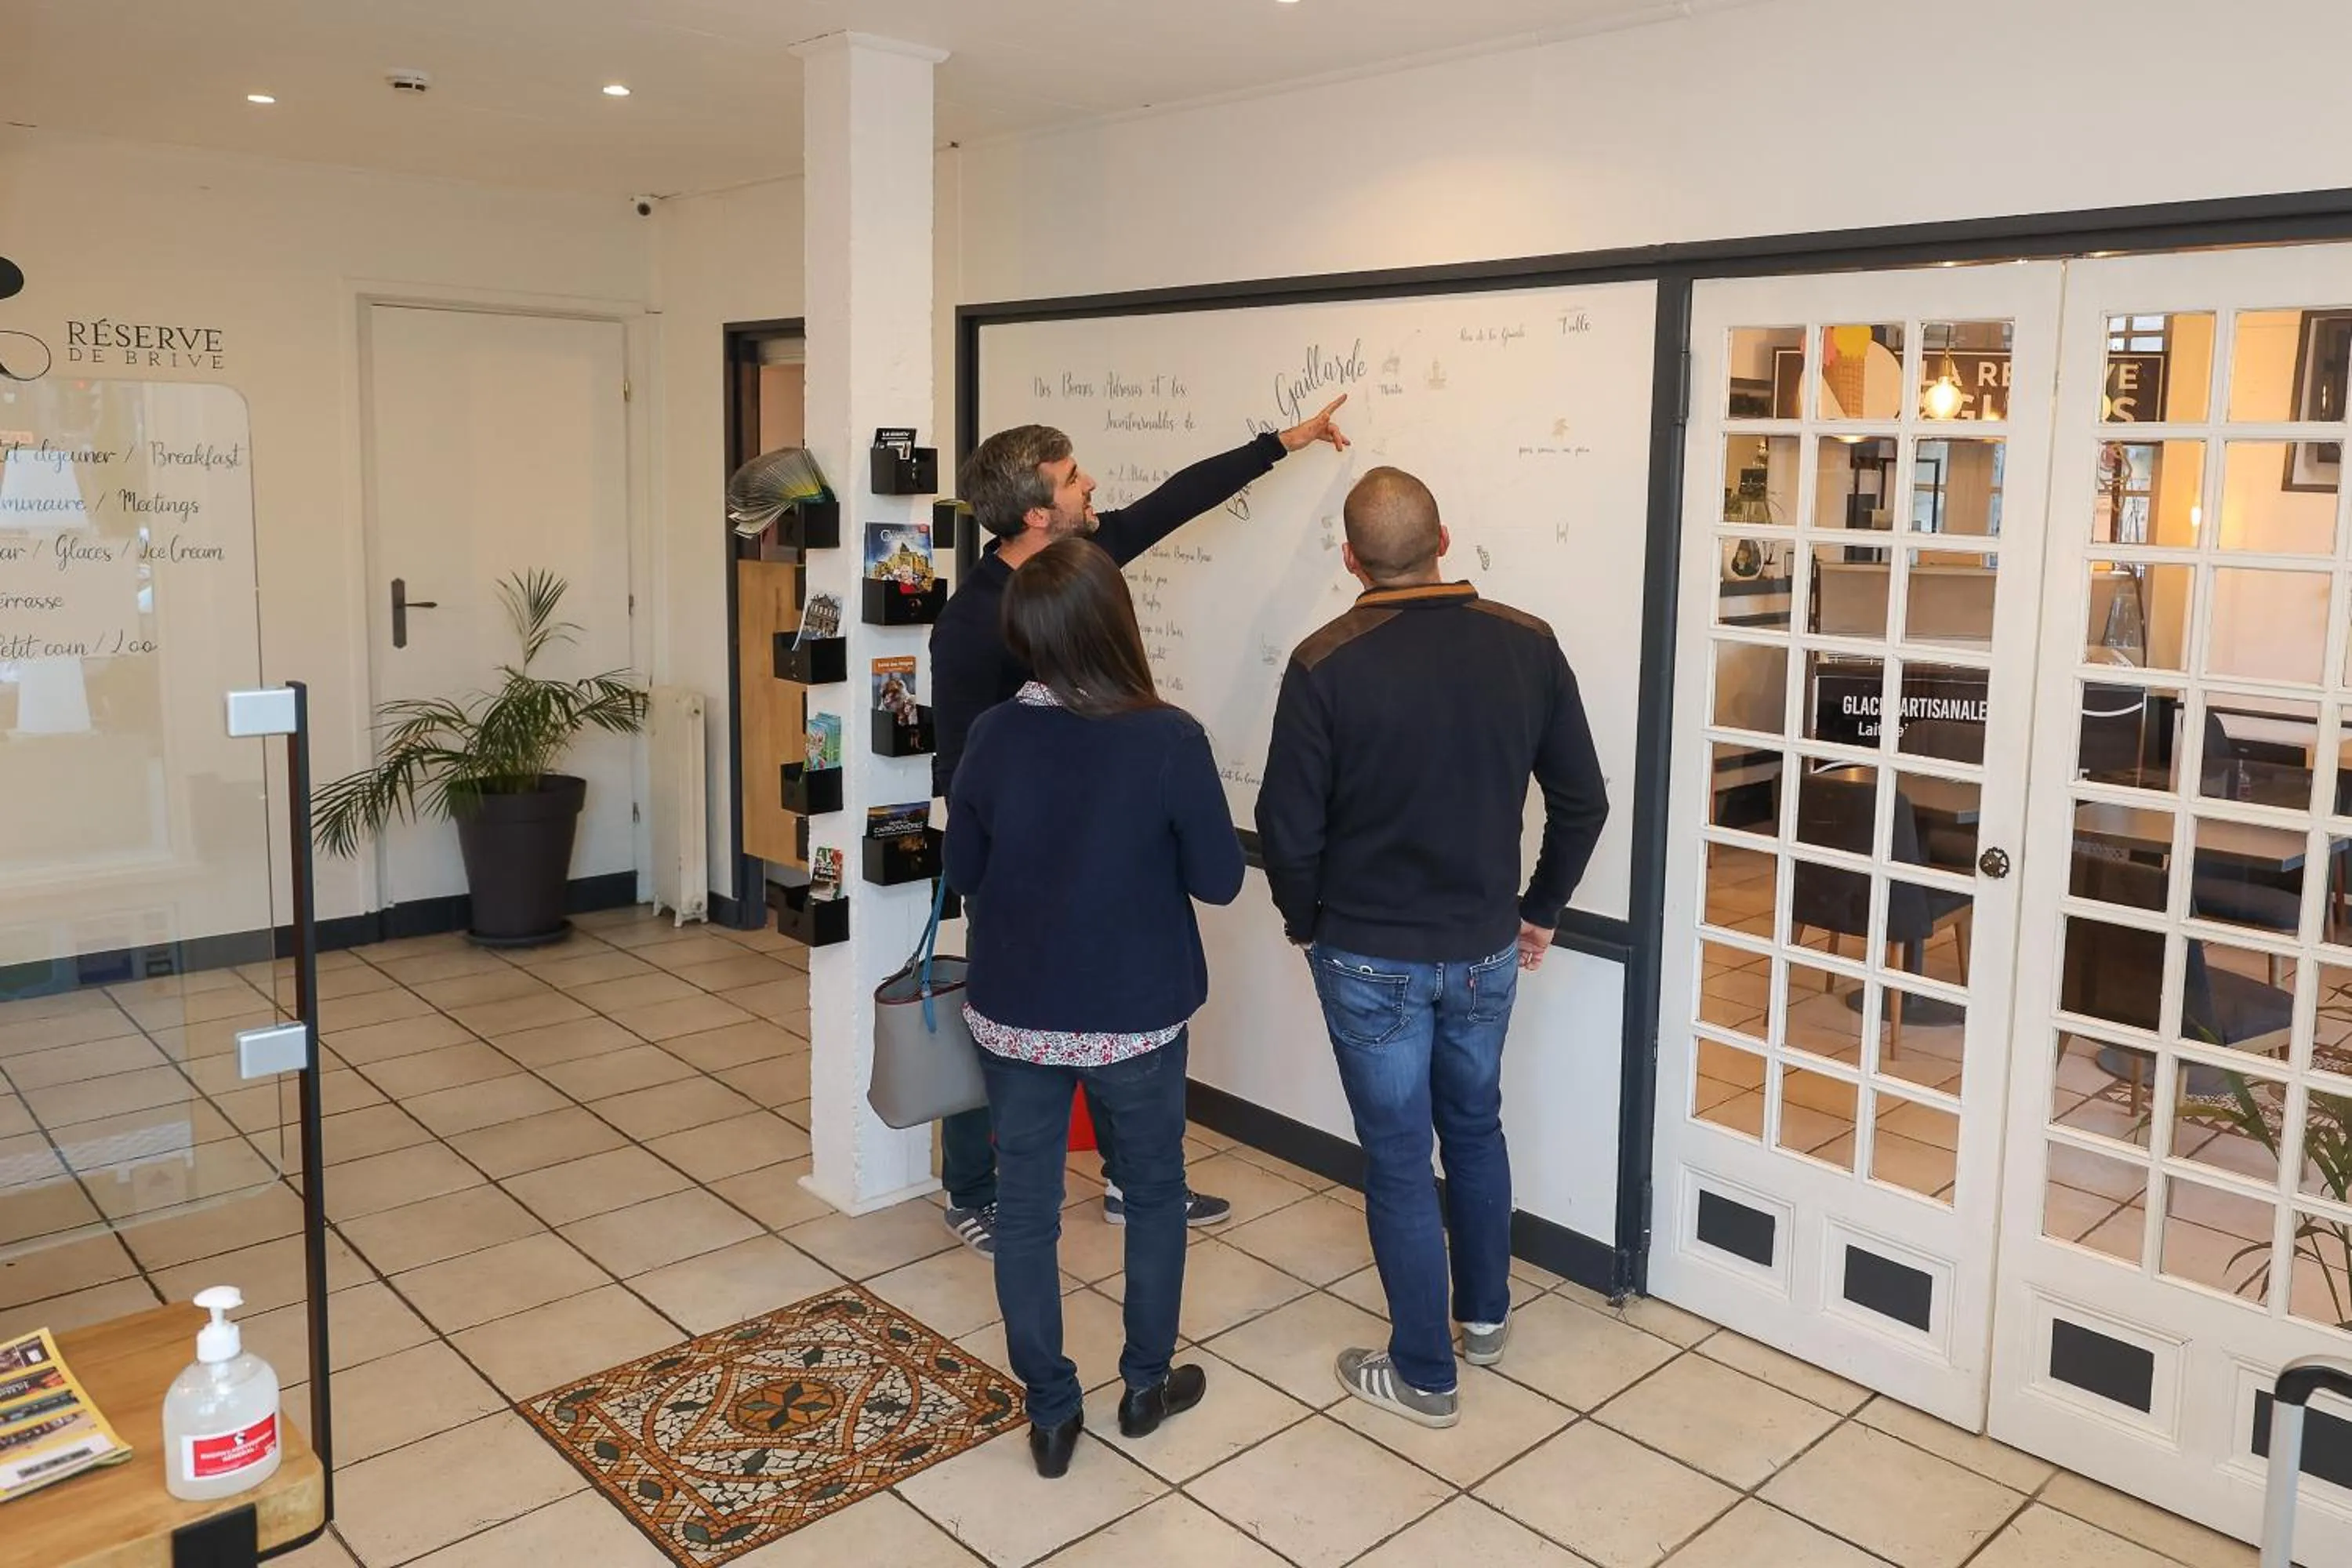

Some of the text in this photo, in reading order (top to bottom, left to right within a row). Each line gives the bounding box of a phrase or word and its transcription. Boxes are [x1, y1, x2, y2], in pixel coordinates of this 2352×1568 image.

[67, 318, 223, 353] RÉSERVE
[1559, 314, 1592, 334] Tulle
[70, 348, 224, 369] DE BRIVE
[1276, 338, 1367, 426] Gaillarde
[150, 441, 243, 470] Breakfast
[118, 488, 201, 523] Meetings
[55, 534, 112, 571] Glaces
[44, 643, 89, 656] coin
[1843, 695, 1883, 715] GLAC
